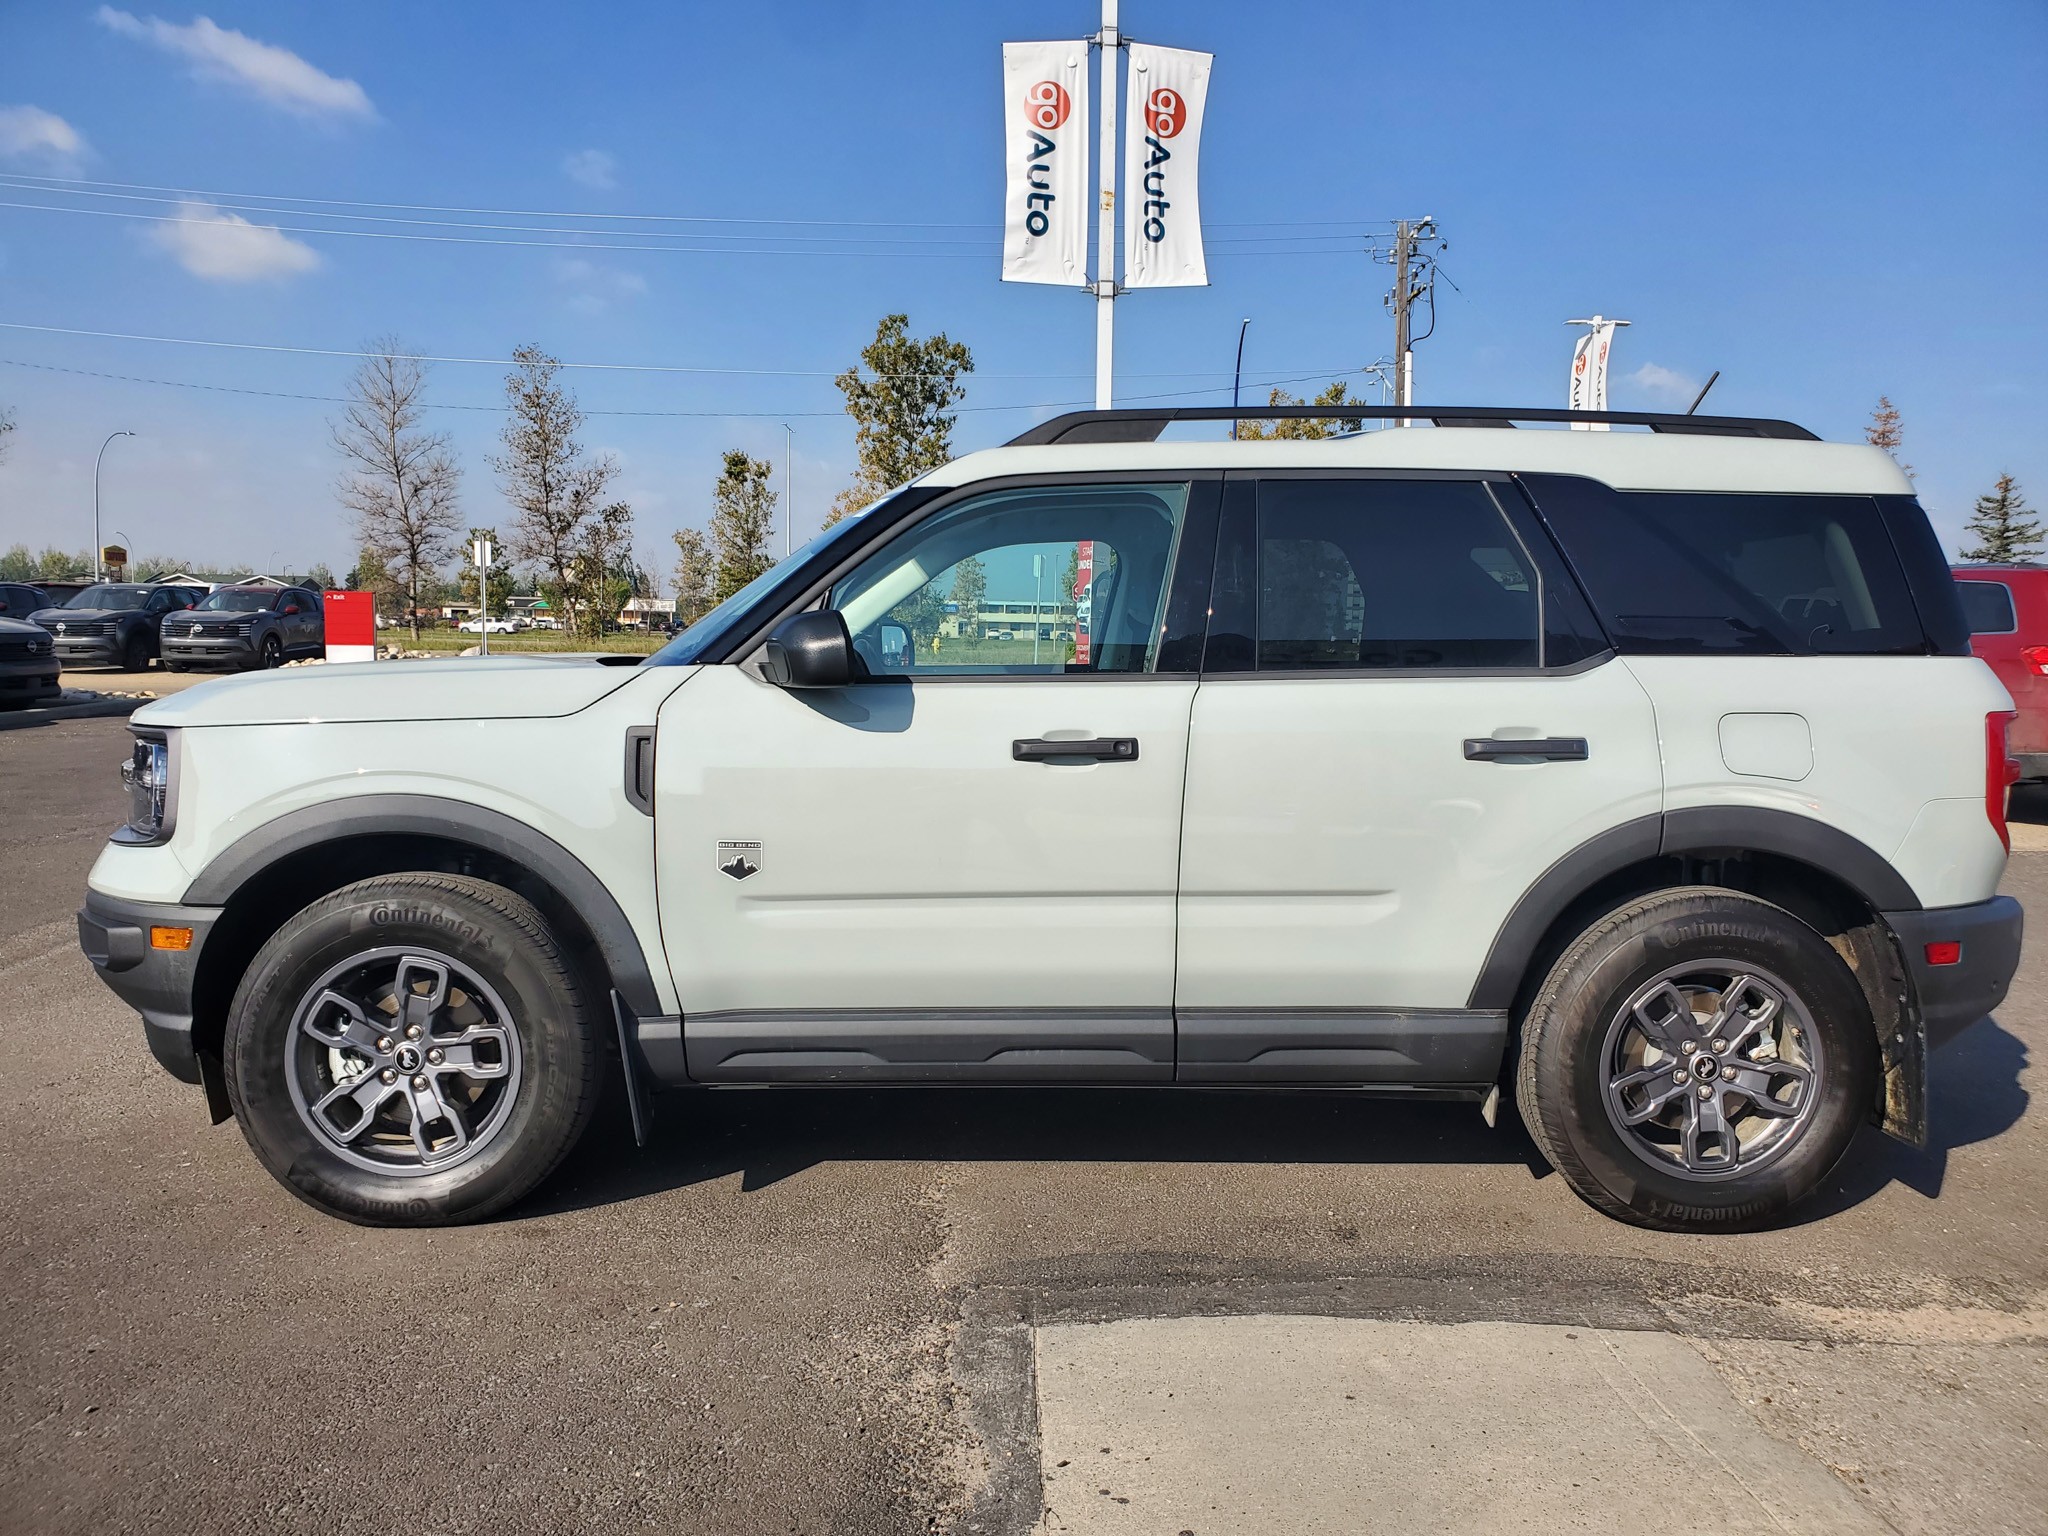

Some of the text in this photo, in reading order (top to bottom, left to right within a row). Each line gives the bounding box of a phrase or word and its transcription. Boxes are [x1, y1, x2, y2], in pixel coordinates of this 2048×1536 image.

[1026, 82, 1058, 128] go
[1147, 90, 1176, 137] go
[1025, 129, 1056, 238] Auto
[1143, 135, 1171, 244] Auto
[1573, 377, 1582, 410] Aut
[368, 902, 484, 943] Continental
[1661, 1200, 1770, 1223] ontinental
